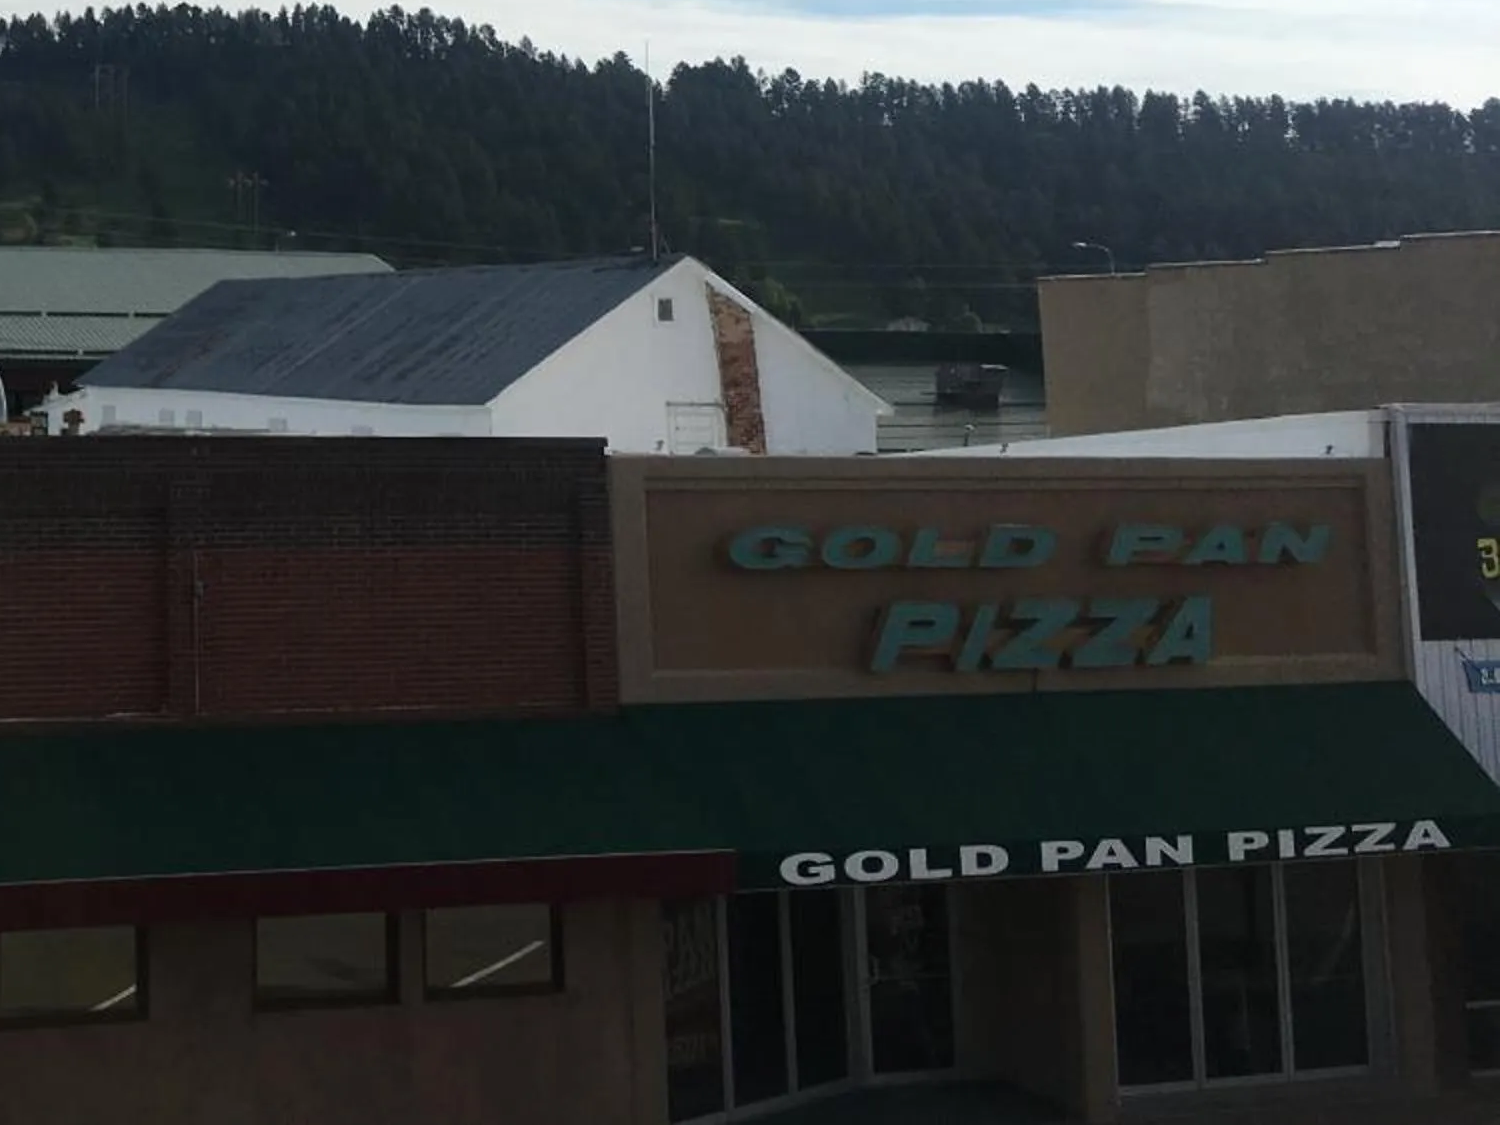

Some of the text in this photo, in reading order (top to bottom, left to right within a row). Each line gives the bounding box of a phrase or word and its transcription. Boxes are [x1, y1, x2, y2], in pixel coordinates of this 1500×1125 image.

[728, 523, 1331, 569] GOLD PAN
[870, 595, 1213, 673] PIZZA
[778, 818, 1452, 886] GOLD PAN PIZZA
